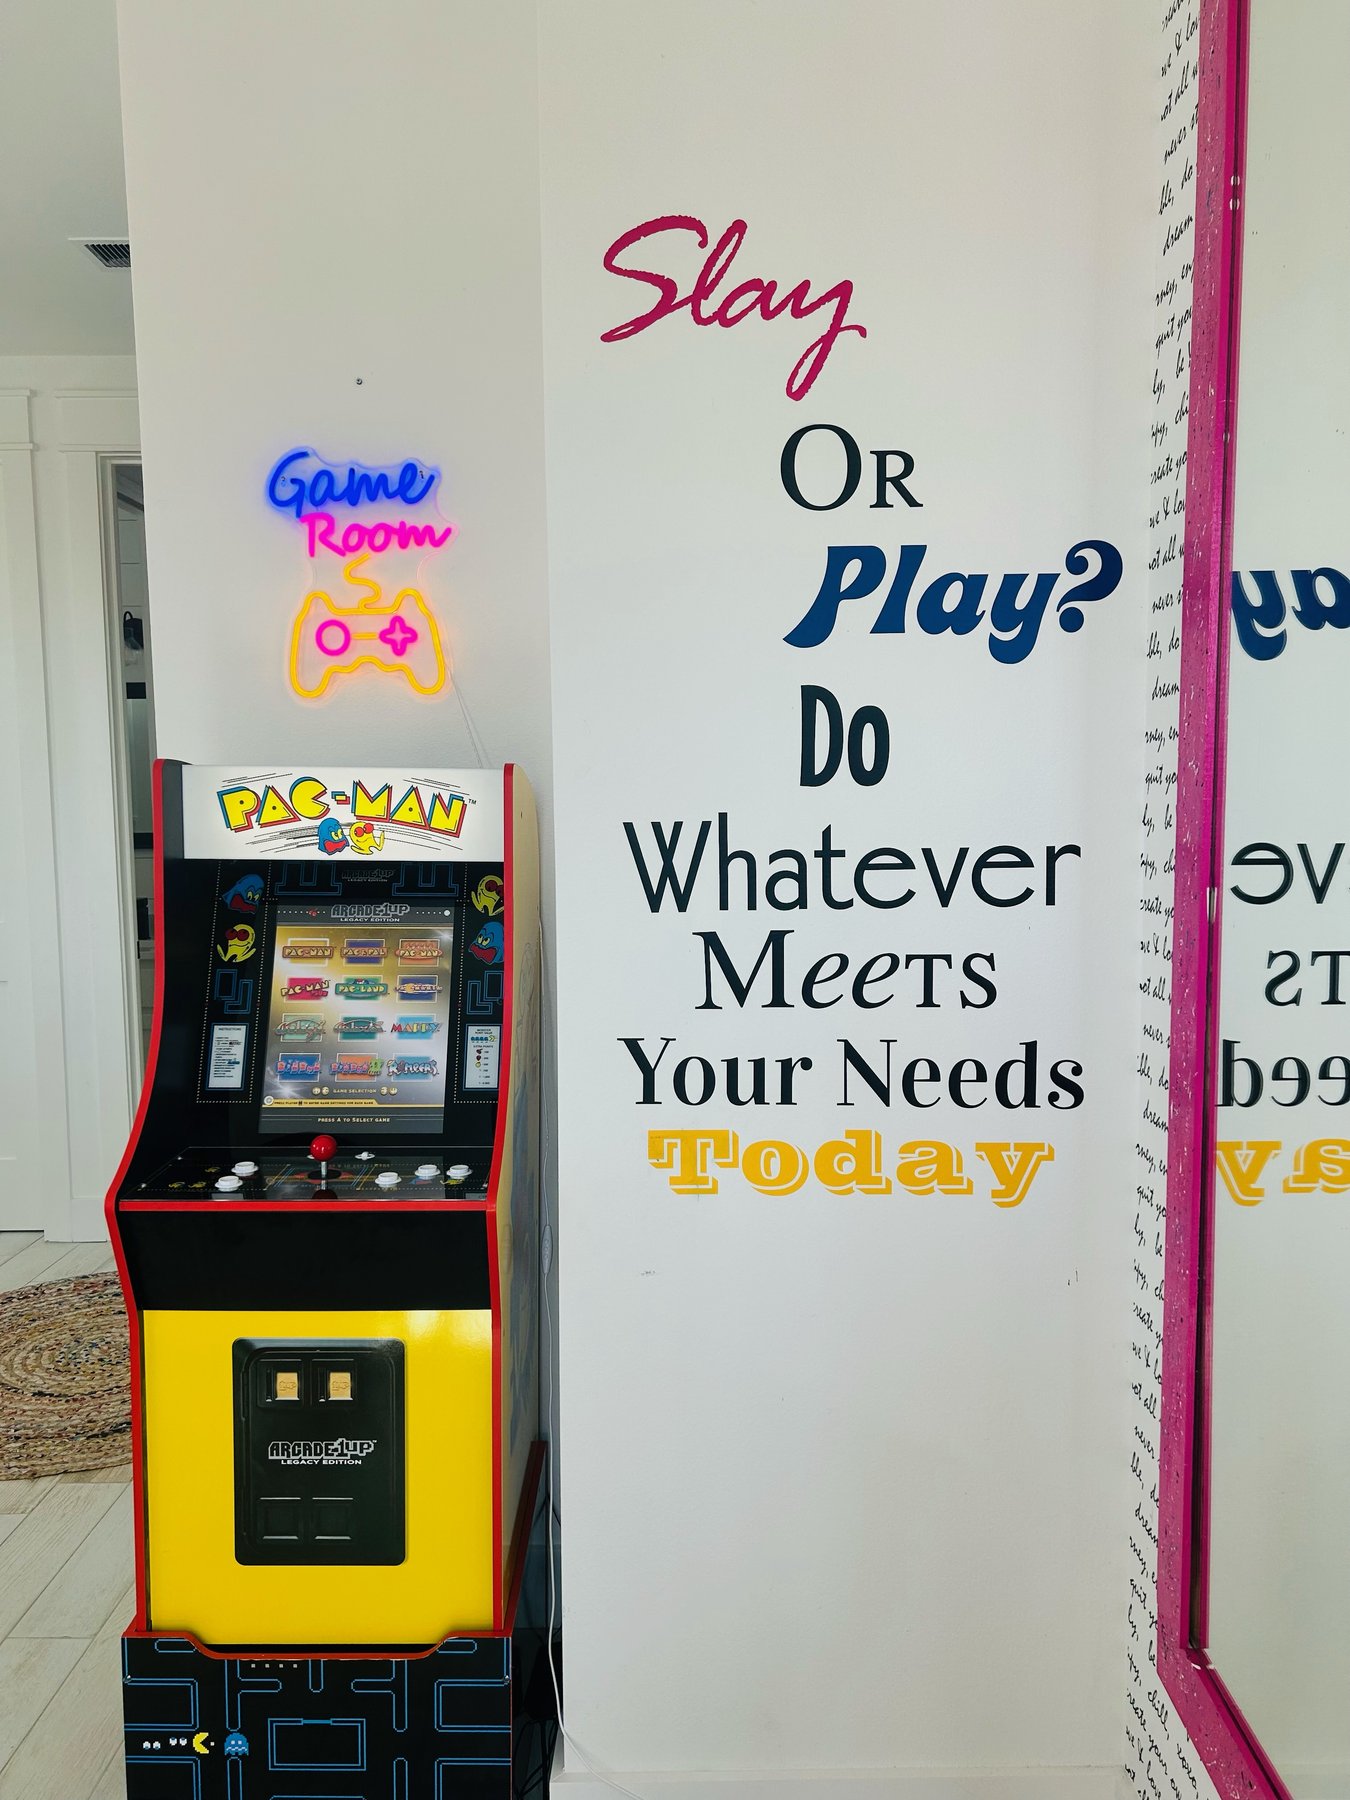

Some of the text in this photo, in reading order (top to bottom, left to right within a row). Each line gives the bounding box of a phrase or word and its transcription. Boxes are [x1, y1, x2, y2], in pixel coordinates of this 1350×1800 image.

[600, 215, 867, 401] Slay
[269, 450, 435, 518] Game
[300, 511, 452, 557] Room
[783, 540, 1123, 664] Play?
[799, 684, 890, 787] Do
[216, 776, 467, 838] PAC-MAN
[623, 812, 1081, 913] Whatever
[617, 1037, 1084, 1109] Your Needs
[648, 1129, 1055, 1208] Today
[269, 1438, 374, 1459] ARCADE1UP
